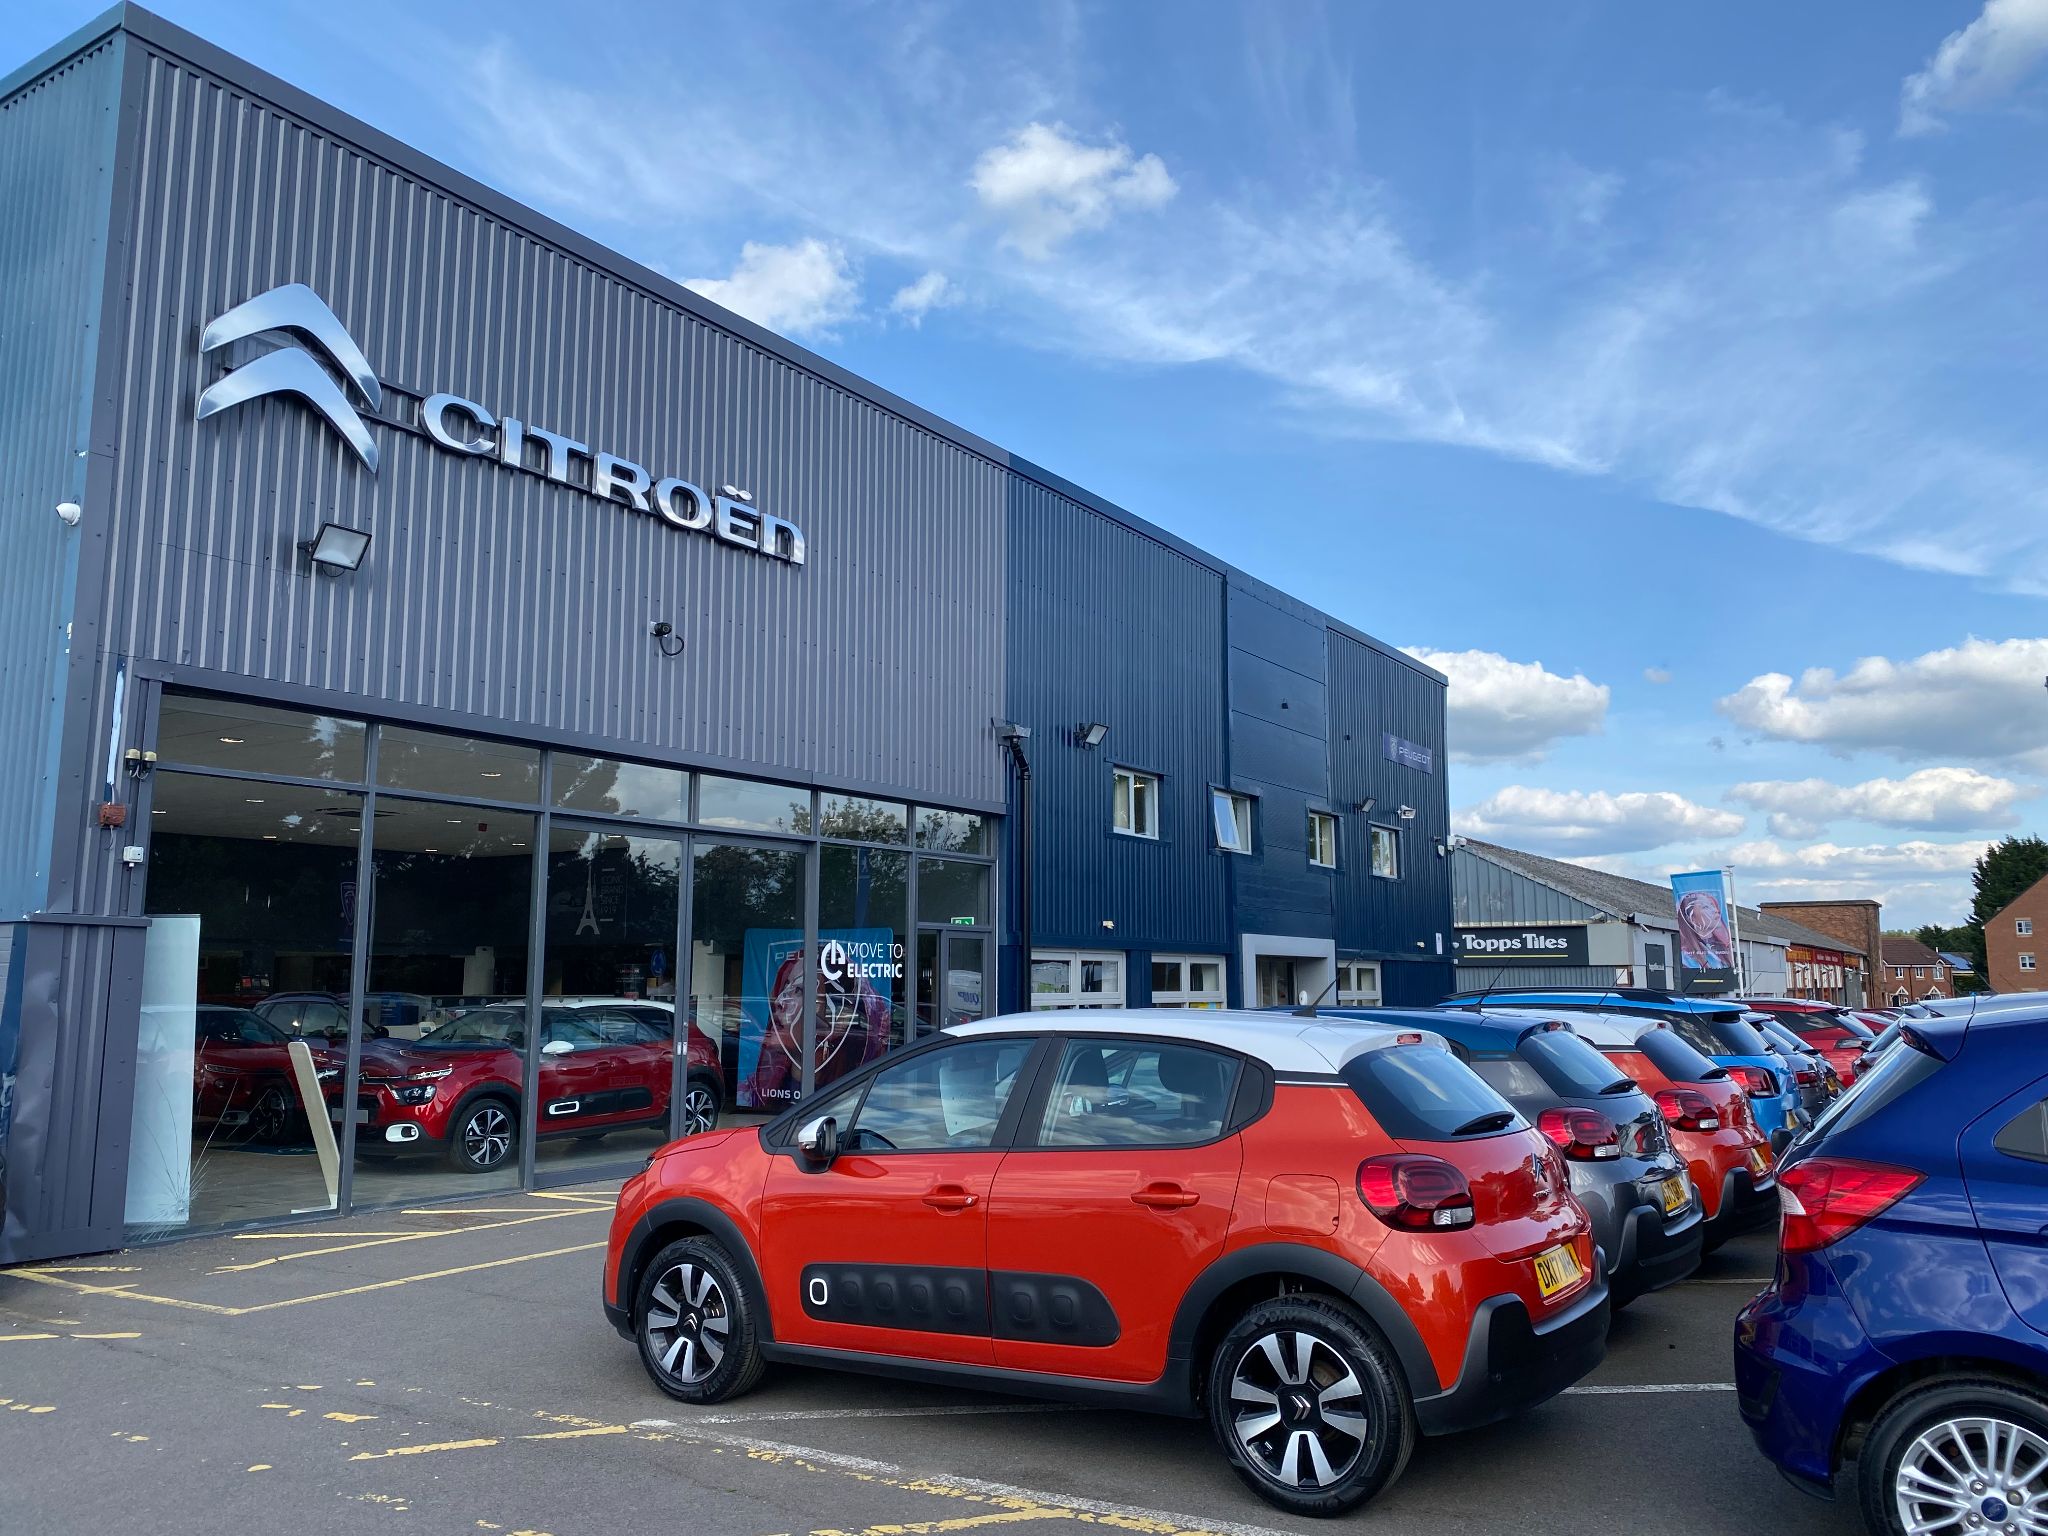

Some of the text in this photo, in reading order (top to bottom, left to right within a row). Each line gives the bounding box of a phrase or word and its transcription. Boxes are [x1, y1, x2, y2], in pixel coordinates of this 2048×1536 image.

[1398, 746, 1431, 766] PEUGEOT
[1461, 933, 1568, 952] Topps Tiles
[848, 943, 904, 959] MOVE TO
[847, 963, 903, 979] ELECTRIC
[761, 1088, 791, 1099] LIONS
